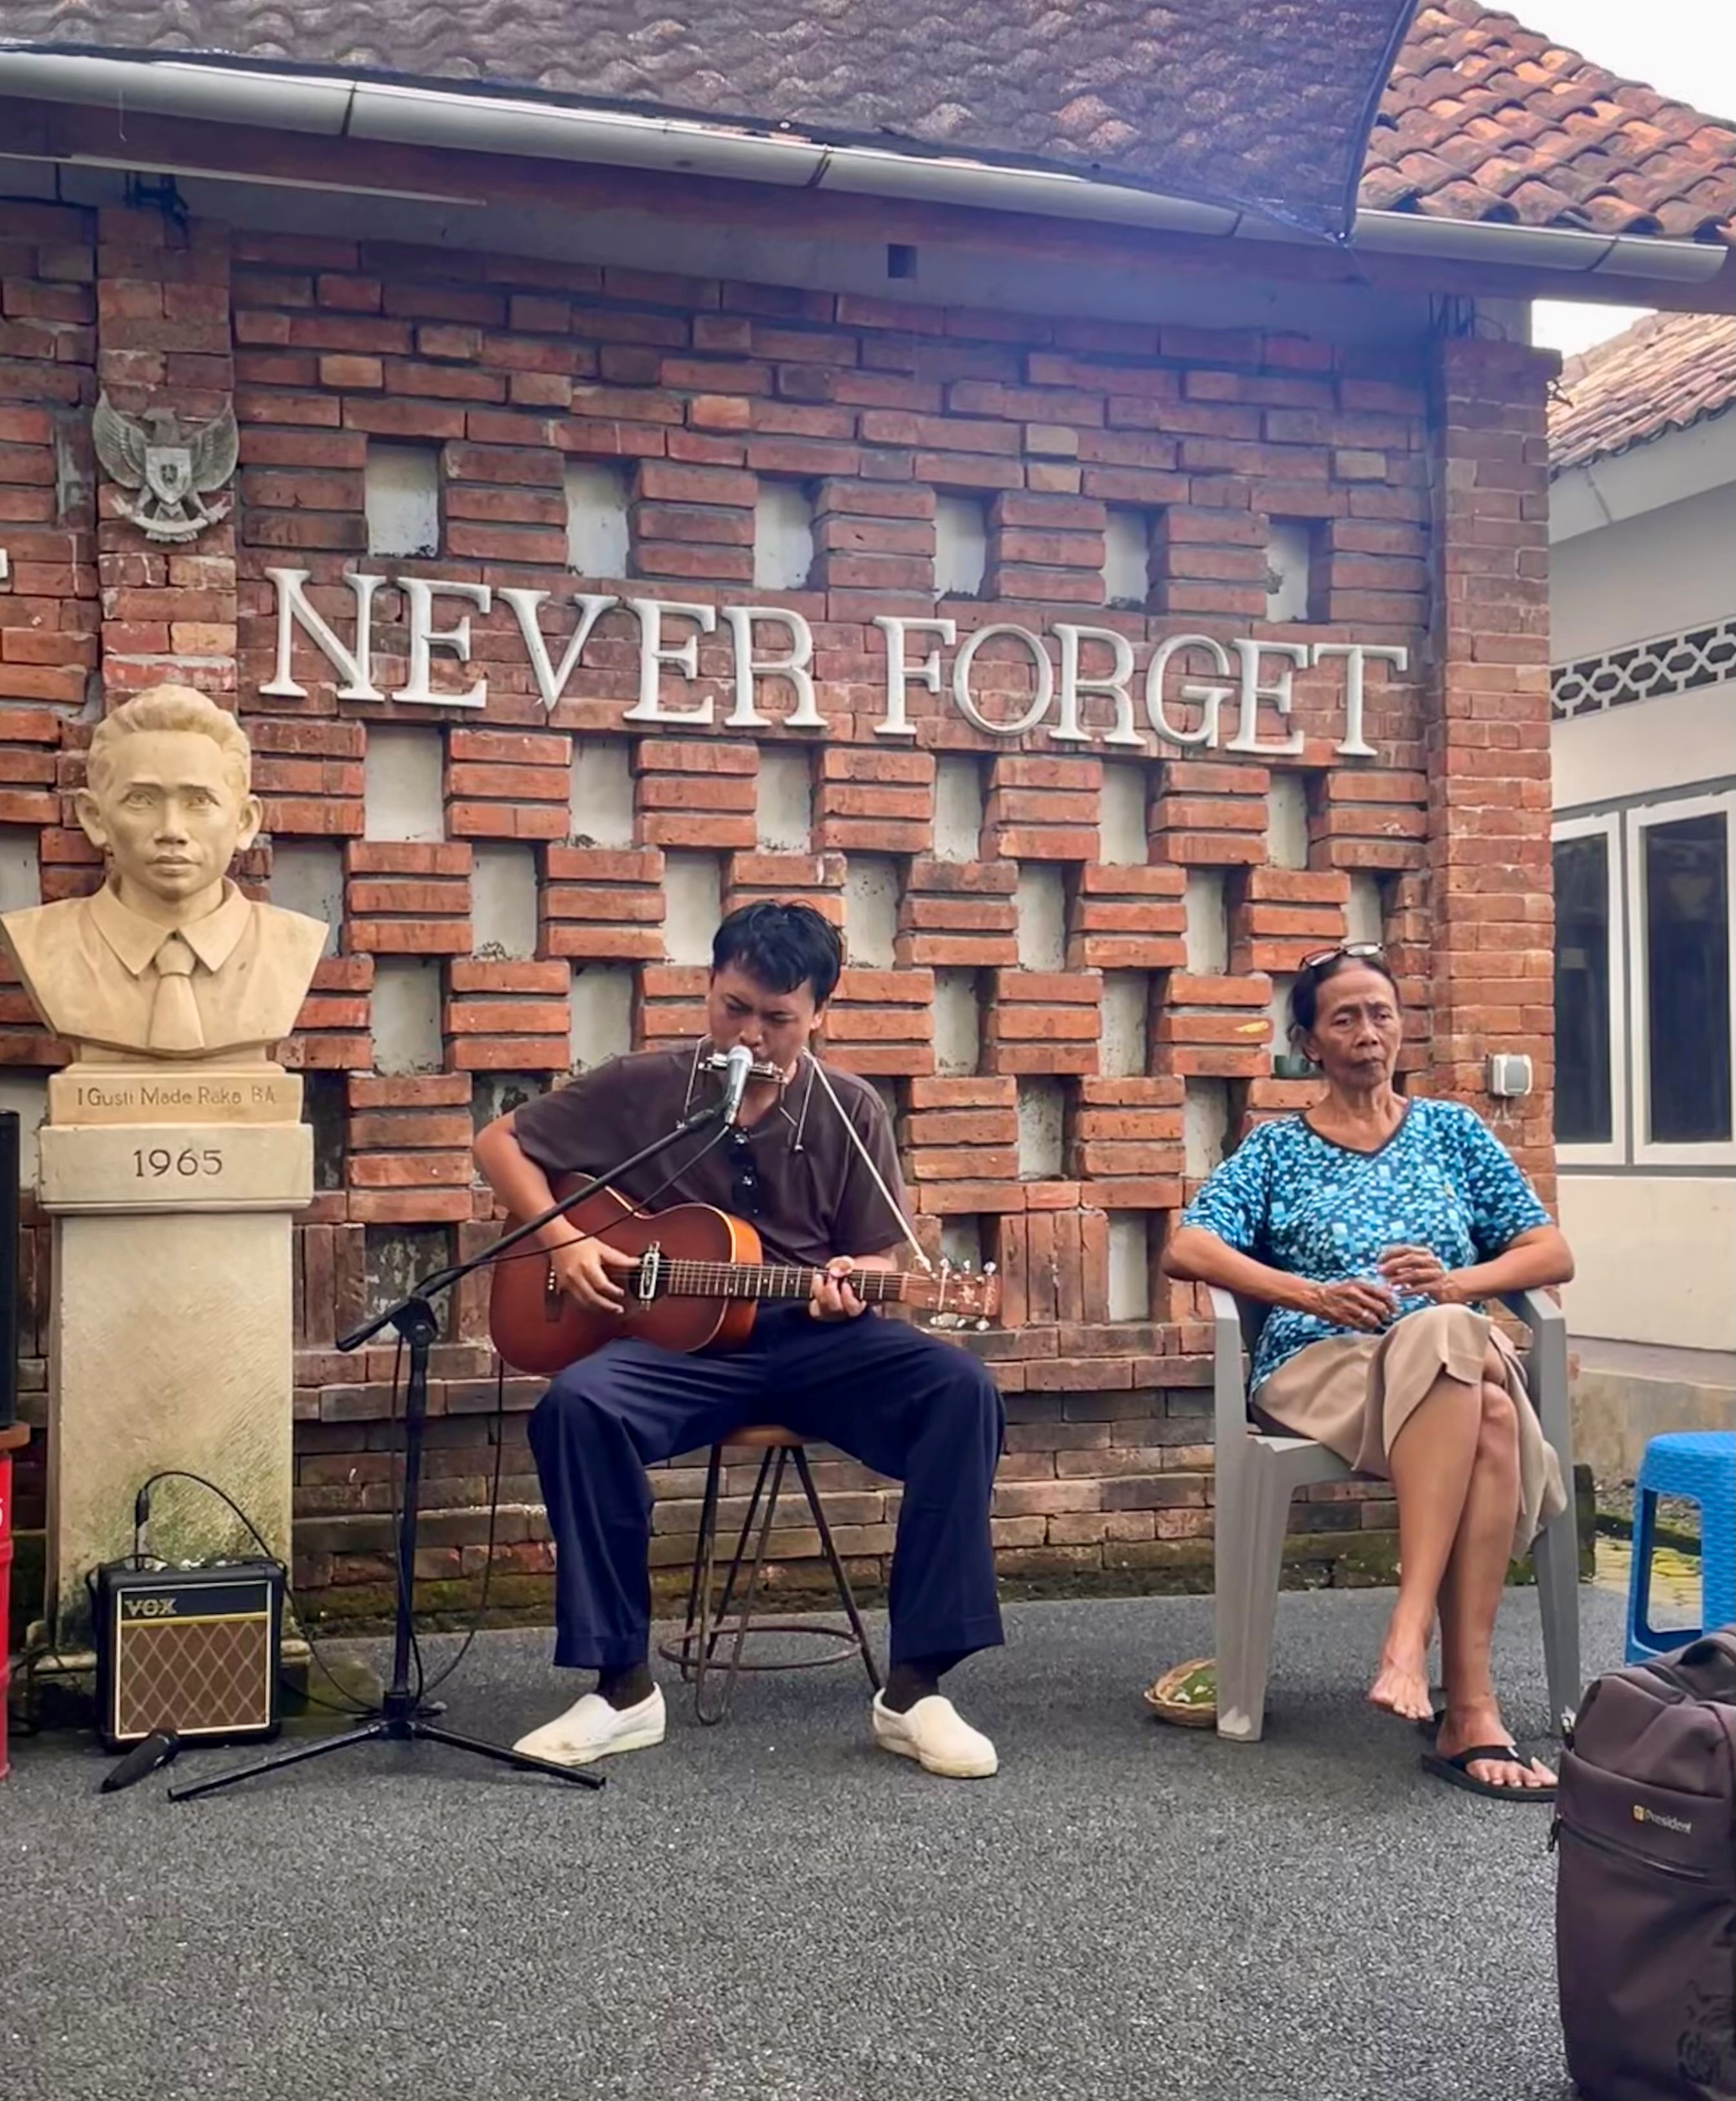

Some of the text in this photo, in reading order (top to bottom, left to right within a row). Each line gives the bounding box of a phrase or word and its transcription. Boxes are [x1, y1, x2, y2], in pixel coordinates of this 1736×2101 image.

[259, 567, 1408, 756] NEVER FORGET
[77, 1085, 276, 1106] I Gusti Made Raka BA
[133, 1148, 223, 1177] 1965
[125, 1597, 177, 1617] VOX
[1646, 1809, 1691, 1834] President
